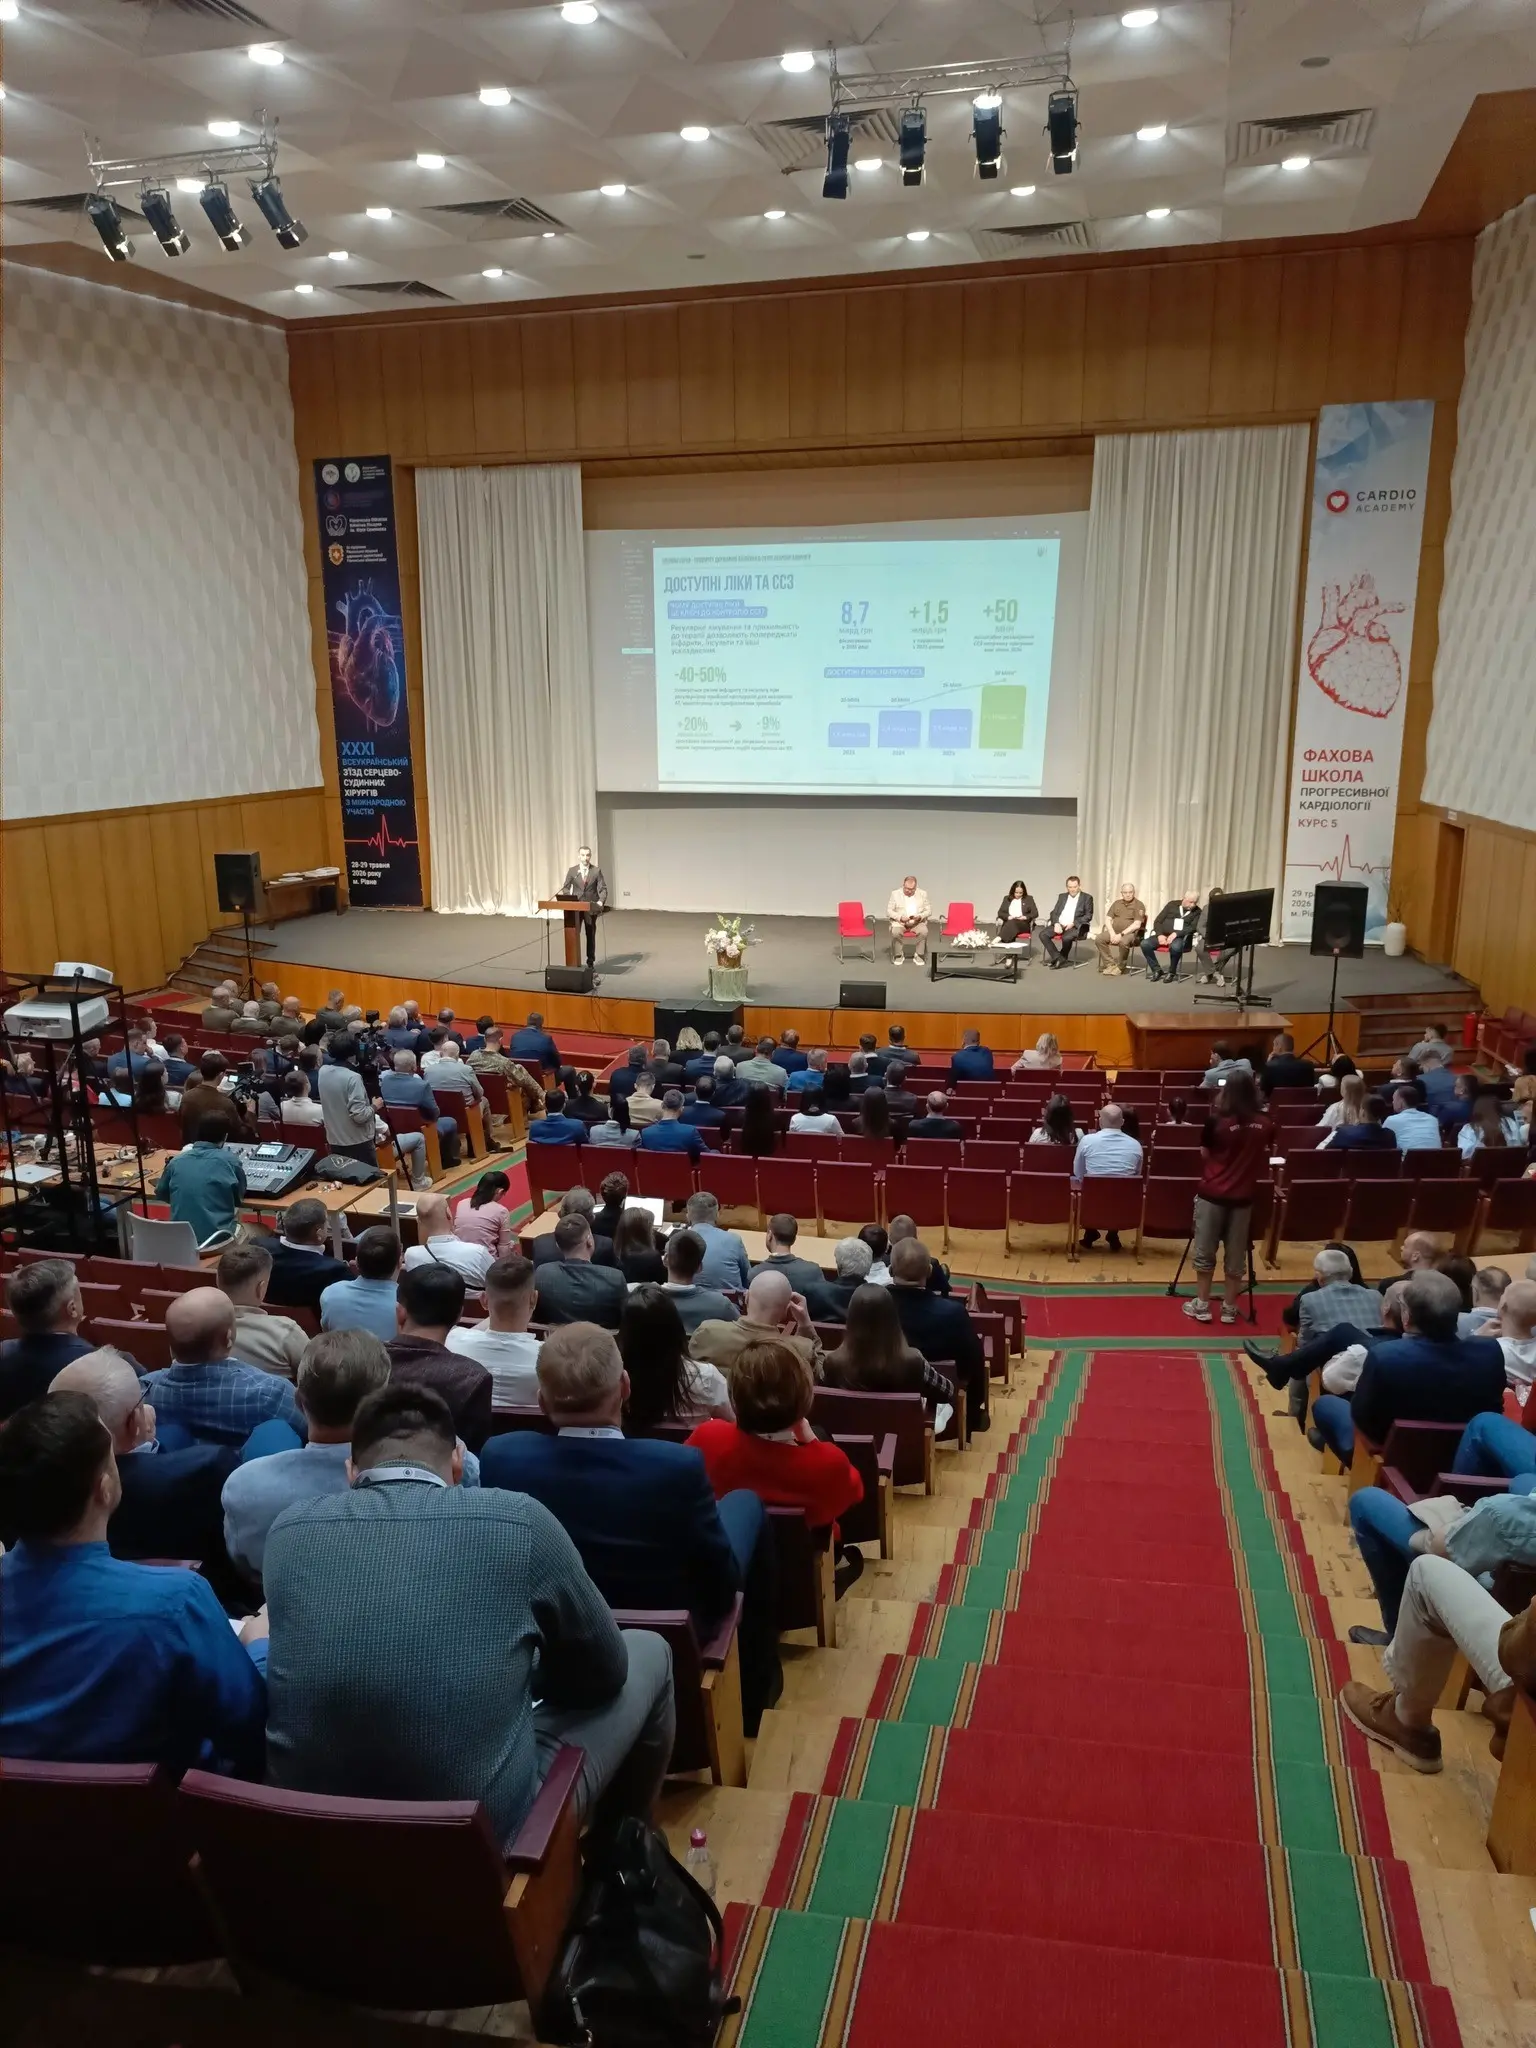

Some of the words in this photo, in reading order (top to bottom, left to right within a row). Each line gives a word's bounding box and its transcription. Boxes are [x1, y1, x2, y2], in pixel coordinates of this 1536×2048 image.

[1357, 489, 1416, 501] CARDIO
[1356, 503, 1415, 512] ACADEMY
[664, 576, 720, 593] ДОСТУПНІ
[724, 576, 752, 591] ЛІКИ
[755, 575, 769, 590] ТА
[772, 574, 794, 590] ССЗ
[841, 601, 869, 626] 8,7
[909, 600, 948, 625] +1,5
[983, 599, 1018, 623] +50
[675, 667, 726, 682] -40-50%
[1304, 749, 1374, 763] ФАХОВА
[343, 757, 408, 766] ВСЕУКРАЇНСЬКИЙ
[364, 768, 401, 777] СЕРЦЕВО-
[1302, 770, 1364, 782] ШКОЛА
[344, 779, 385, 787] СУДИННИХ
[345, 789, 378, 797] ХІРУРГІВ
[1300, 787, 1390, 797] ПРОГРЕСИВНОЇ
[352, 798, 406, 807] МІЖНАРОДНОЮ
[1299, 800, 1371, 812] КАРДІОЛОГІЇ
[347, 808, 375, 816] УЧАСТЮ
[1298, 818, 1328, 828] КУРС
[1331, 819, 1338, 828] 5
[367, 870, 381, 878] року
[361, 878, 377, 886] Рівне
